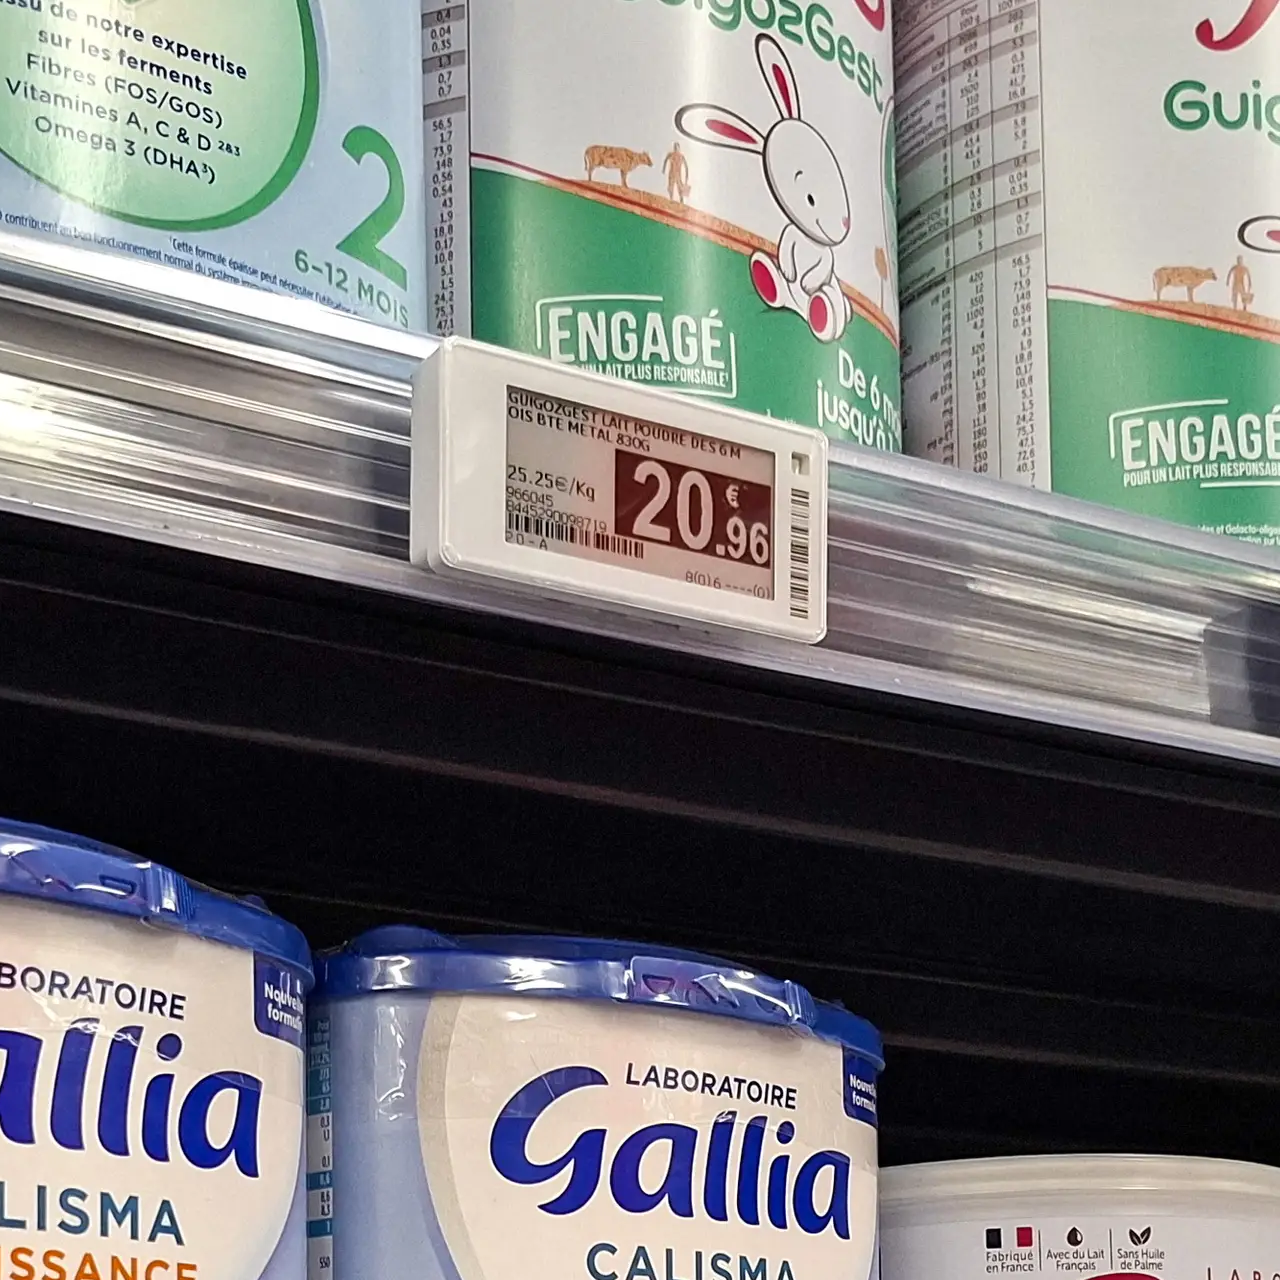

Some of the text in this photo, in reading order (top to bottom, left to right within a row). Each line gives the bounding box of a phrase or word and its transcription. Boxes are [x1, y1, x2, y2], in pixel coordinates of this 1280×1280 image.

[87, 13, 248, 80] notre expertise
[26, 53, 224, 128] Fibres (FOS/GOS)
[118, 49, 213, 95] ferments
[7, 78, 118, 123] Vitamines
[35, 116, 136, 156] Omega 3
[336, 126, 407, 292] 2
[357, 283, 408, 329] MOIS
[548, 306, 726, 369] ENGAGÉ
[838, 348, 880, 410] De 6
[508, 407, 650, 453] OIS BTE METAL 830G
[602, 411, 632, 429] LAIT
[634, 421, 687, 446] POUDRE
[507, 465, 595, 502] 25.25€/Kg
[1123, 466, 1219, 487] POUR UN LAIT PLUS
[625, 1062, 798, 1110] LABORATOIRE
[489, 1064, 852, 1240] Gallia
[986, 1249, 1033, 1262] Fabriqué
[1000, 1261, 1034, 1272] France
